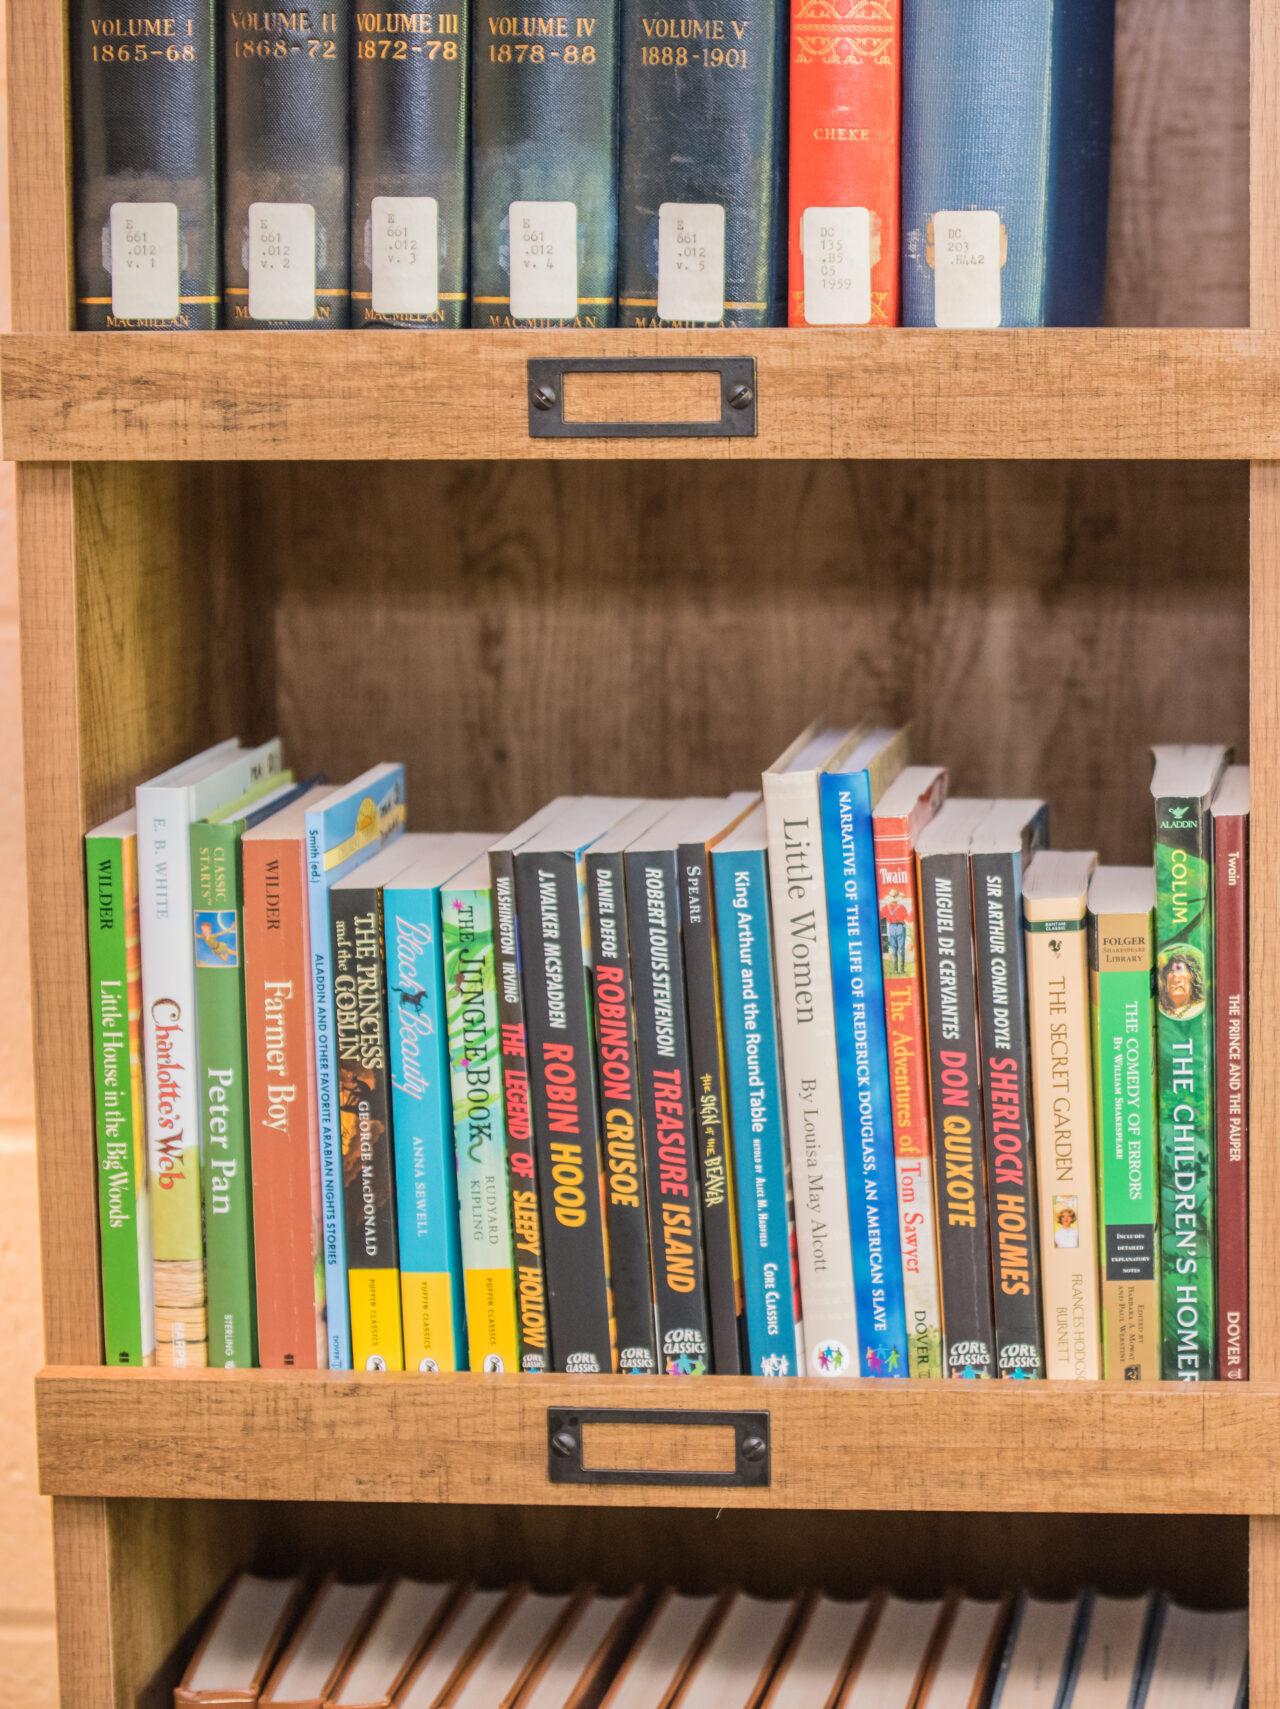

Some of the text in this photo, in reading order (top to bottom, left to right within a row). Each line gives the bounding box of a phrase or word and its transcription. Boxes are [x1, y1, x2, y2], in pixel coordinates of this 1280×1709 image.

[91, 18, 193, 37] VOLUME I
[91, 43, 196, 62] 1865-68
[231, 10, 314, 32] VOLUME
[234, 41, 337, 59] 1868-72
[357, 13, 458, 34] VOLUME III
[358, 41, 458, 60] 1872-78
[488, 16, 596, 37] VOLUME IV
[488, 41, 596, 63] 1878-88
[641, 46, 748, 67] 1888-1901
[642, 19, 748, 40] VOLUME V
[813, 127, 869, 141] CHEKE
[523, 232, 543, 242] 661
[820, 228, 834, 237] DC
[821, 240, 842, 250] 135
[821, 279, 851, 289] 1959
[1159, 818, 1198, 829] ALADDIN
[98, 860, 114, 931] WILDER
[155, 862, 169, 919] WHITE
[213, 847, 226, 903] CLASSIC
[1171, 848, 1188, 924] COLUM
[496, 877, 516, 955] WASHINGTON
[732, 871, 756, 966] King Arthur
[783, 817, 817, 1025] Little Women
[1103, 936, 1145, 946] FOLGER
[333, 974, 360, 1062] GOBLIN
[357, 964, 384, 1069] PRINCESS
[391, 914, 436, 1101] Black Beauty
[543, 942, 566, 1029] MCSPADDEN
[650, 972, 675, 1058] STEVENSON
[261, 980, 296, 1134] Farmer Boy
[457, 948, 492, 1158] JUNGLE BOOK
[595, 964, 639, 1208] ROBINSON CRUSOE
[852, 1002, 876, 1176] FREDERICK DOUGLASS,
[1228, 1018, 1240, 1162] PRINCE PAUPER
[100, 980, 130, 1229] Little House Big Woods
[151, 998, 186, 1190] Charlotte's Web
[1049, 1023, 1073, 1182] SECRET GARDEN
[1125, 1037, 1142, 1200] COMEDY ERRORS
[207, 1067, 236, 1215] Peter Pan
[542, 1042, 587, 1228] ROBIN HOOD
[939, 1050, 976, 1228] DON QUIXOTE
[414, 1181, 428, 1238] SEWELL
[652, 1068, 696, 1293] TREASURE ISLAND
[989, 1056, 1030, 1297] SHERLOCK HOLMES
[1173, 1104, 1197, 1275] CHILDREN'S
[900, 1162, 924, 1275] Tom Sawyer
[512, 1190, 547, 1348] SLEEPY HOLLOW
[223, 1314, 234, 1356] STERLING
[1226, 1311, 1240, 1366] DOVER
